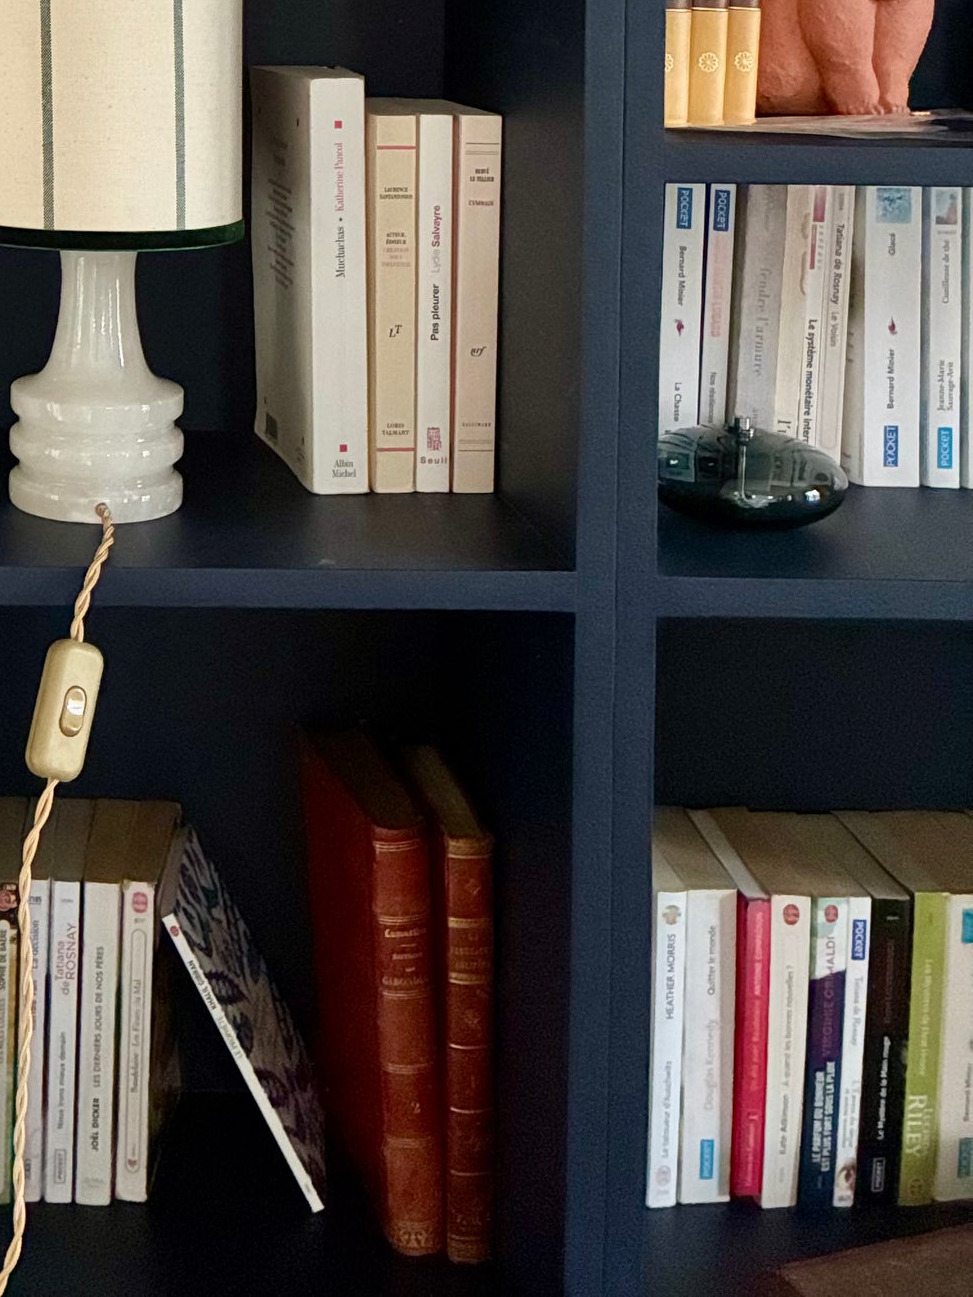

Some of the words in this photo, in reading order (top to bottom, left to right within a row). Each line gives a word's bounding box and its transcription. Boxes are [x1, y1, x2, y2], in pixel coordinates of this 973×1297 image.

[334, 172, 345, 212] Katherine
[679, 189, 690, 228] POCKET
[717, 190, 728, 230] POCKET
[431, 205, 443, 248] Salvayre
[834, 223, 845, 257] Tatiana
[335, 226, 346, 279] Muchachas
[677, 245, 687, 279] Bernard
[833, 259, 841, 271] de
[941, 253, 950, 264] de
[430, 283, 441, 316] pleurer
[677, 280, 687, 307] Minier
[831, 271, 843, 305] Rosnay
[430, 320, 440, 341] Pas
[808, 318, 818, 331] Le
[831, 312, 840, 322] Le
[830, 322, 840, 348] Voisin
[805, 331, 815, 369] système
[887, 348, 895, 375] Minier
[674, 381, 682, 392] La
[803, 370, 813, 417] monétaire
[886, 376, 895, 410] Bernard
[937, 359, 946, 412] Jeanne-Marie
[673, 392, 683, 422] Chasse
[419, 456, 448, 465] Seuil
[940, 429, 950, 467] POCKET
[331, 468, 357, 479] Michel
[333, 459, 355, 469] Albin
[65, 922, 77, 980] ROSNAY
[667, 933, 677, 973] MORRIS
[708, 925, 716, 955] monde
[853, 921, 864, 958] POCKET
[0, 953, 7, 964] DE
[55, 940, 65, 982] Tatiana
[95, 946, 105, 970] PÈRES
[61, 981, 70, 997] de
[95, 970, 104, 991] NOS
[707, 965, 716, 996] Quitter
[95, 994, 103, 1004] DE
[665, 974, 675, 1020] HEATHER
[94, 1005, 103, 1032] JOURS
[93, 1034, 102, 1071] DERNIERS
[705, 1019, 719, 1065] Kennedy
[93, 1073, 102, 1088] LES
[879, 1059, 889, 1078] Main
[704, 1065, 717, 1111] Douglas
[825, 1083, 835, 1094] LA
[878, 1087, 887, 1098] de
[91, 1097, 100, 1129] DICKER
[780, 1094, 789, 1133] Atkinson
[824, 1094, 834, 1115] SOUS
[823, 1115, 833, 1135] FORT
[876, 1129, 885, 1140] Le
[905, 1094, 927, 1158] RILEY
[91, 1131, 100, 1152] JOËL
[779, 1133, 787, 1155] Kate
[822, 1136, 832, 1157] PLUS
[820, 1157, 830, 1172] EST
